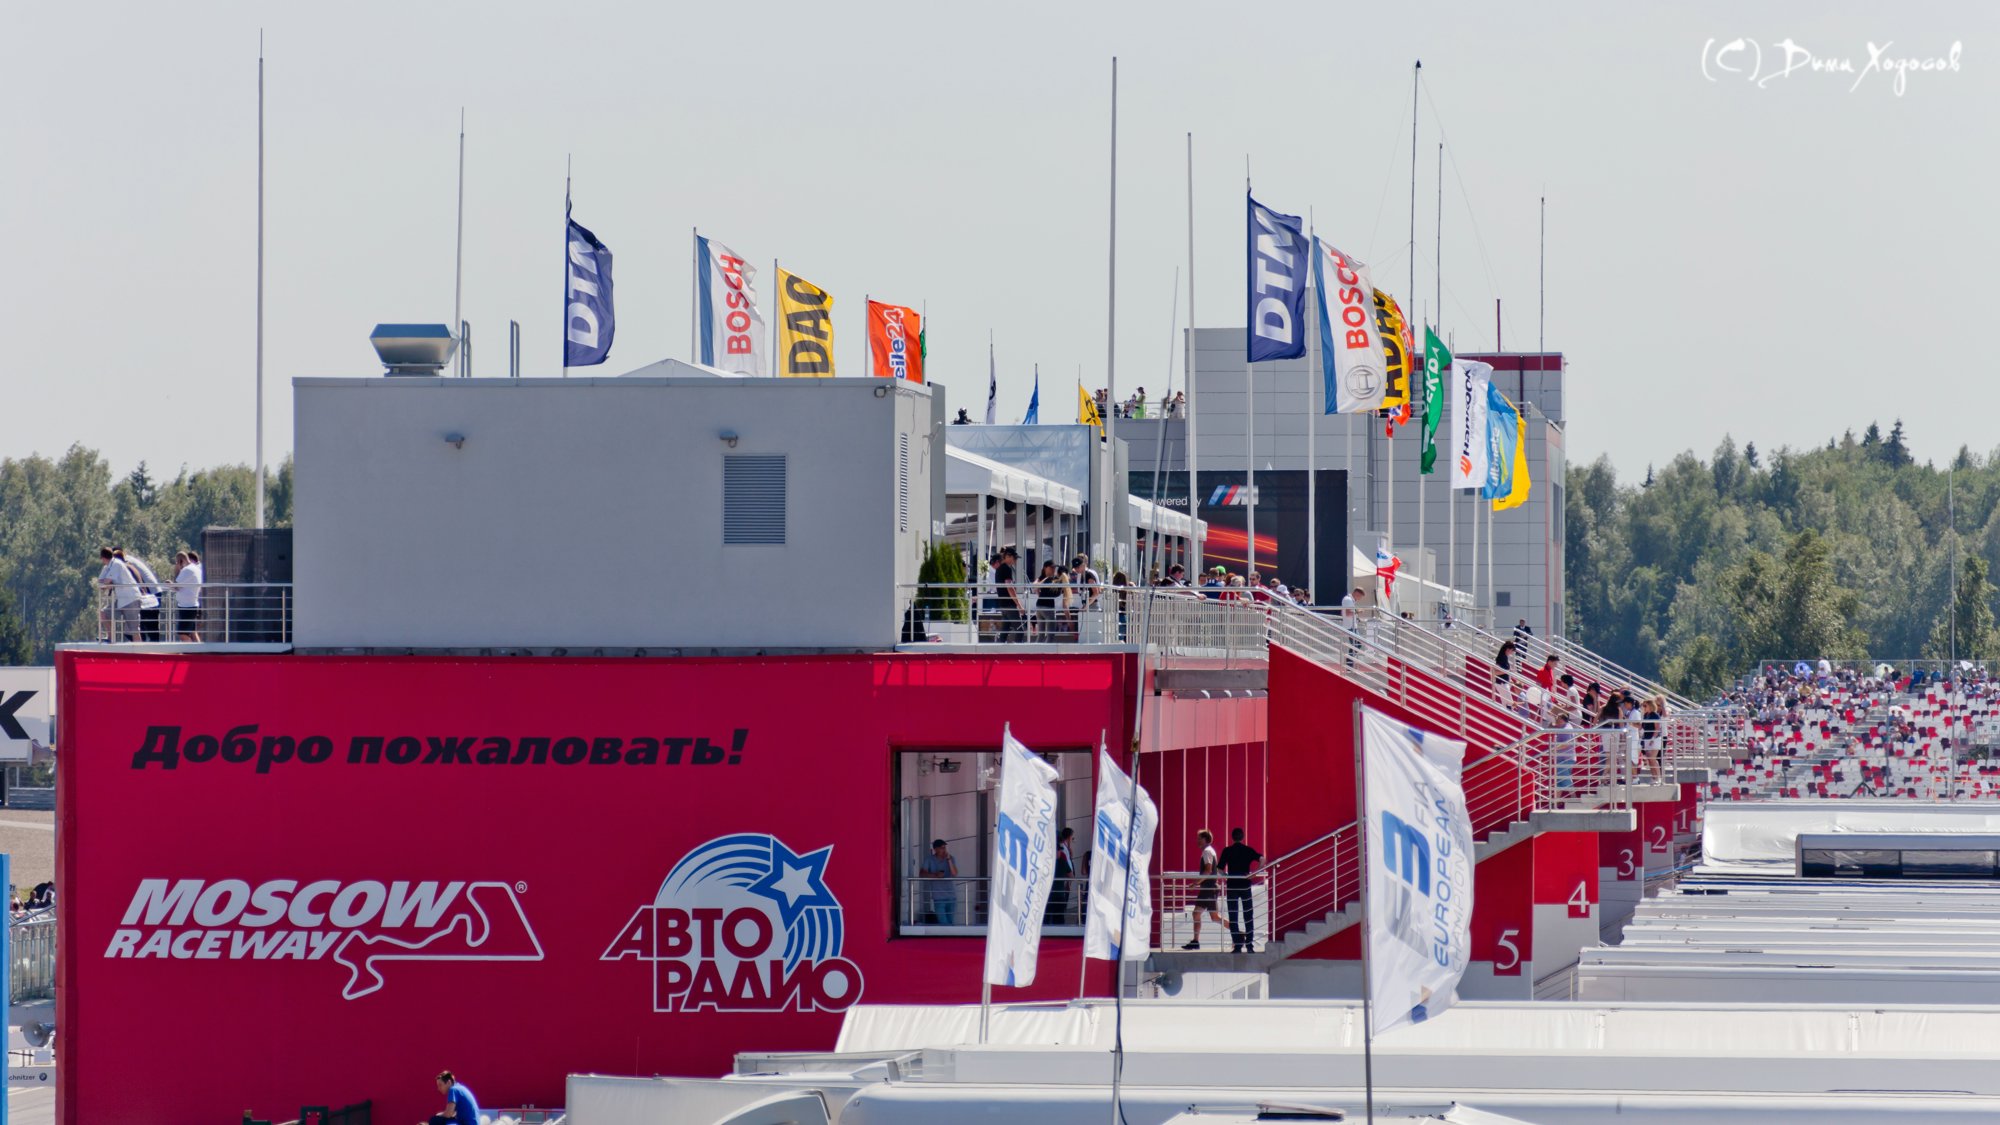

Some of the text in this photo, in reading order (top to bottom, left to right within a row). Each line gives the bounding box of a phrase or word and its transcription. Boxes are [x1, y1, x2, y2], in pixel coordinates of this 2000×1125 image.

[719, 254, 752, 355] BOSCH
[785, 274, 830, 375] DAC
[1330, 249, 1370, 350] BOSCH
[884, 308, 906, 379] eile24
[131, 724, 749, 774] Добро пожаловать!
[1415, 781, 1428, 828] FIA
[1679, 808, 1690, 830] 1
[1618, 849, 1635, 876] 3
[1652, 826, 1667, 850] 2
[1018, 798, 1052, 937] EUROPEAN
[1434, 788, 1453, 967] EUROPEAN
[120, 878, 466, 928] MOSCOW
[1567, 880, 1590, 914] 4
[104, 930, 342, 960] RACEWAY
[600, 905, 774, 961] АВТО
[1496, 929, 1519, 970] 5
[653, 957, 865, 1013] РАДИО
